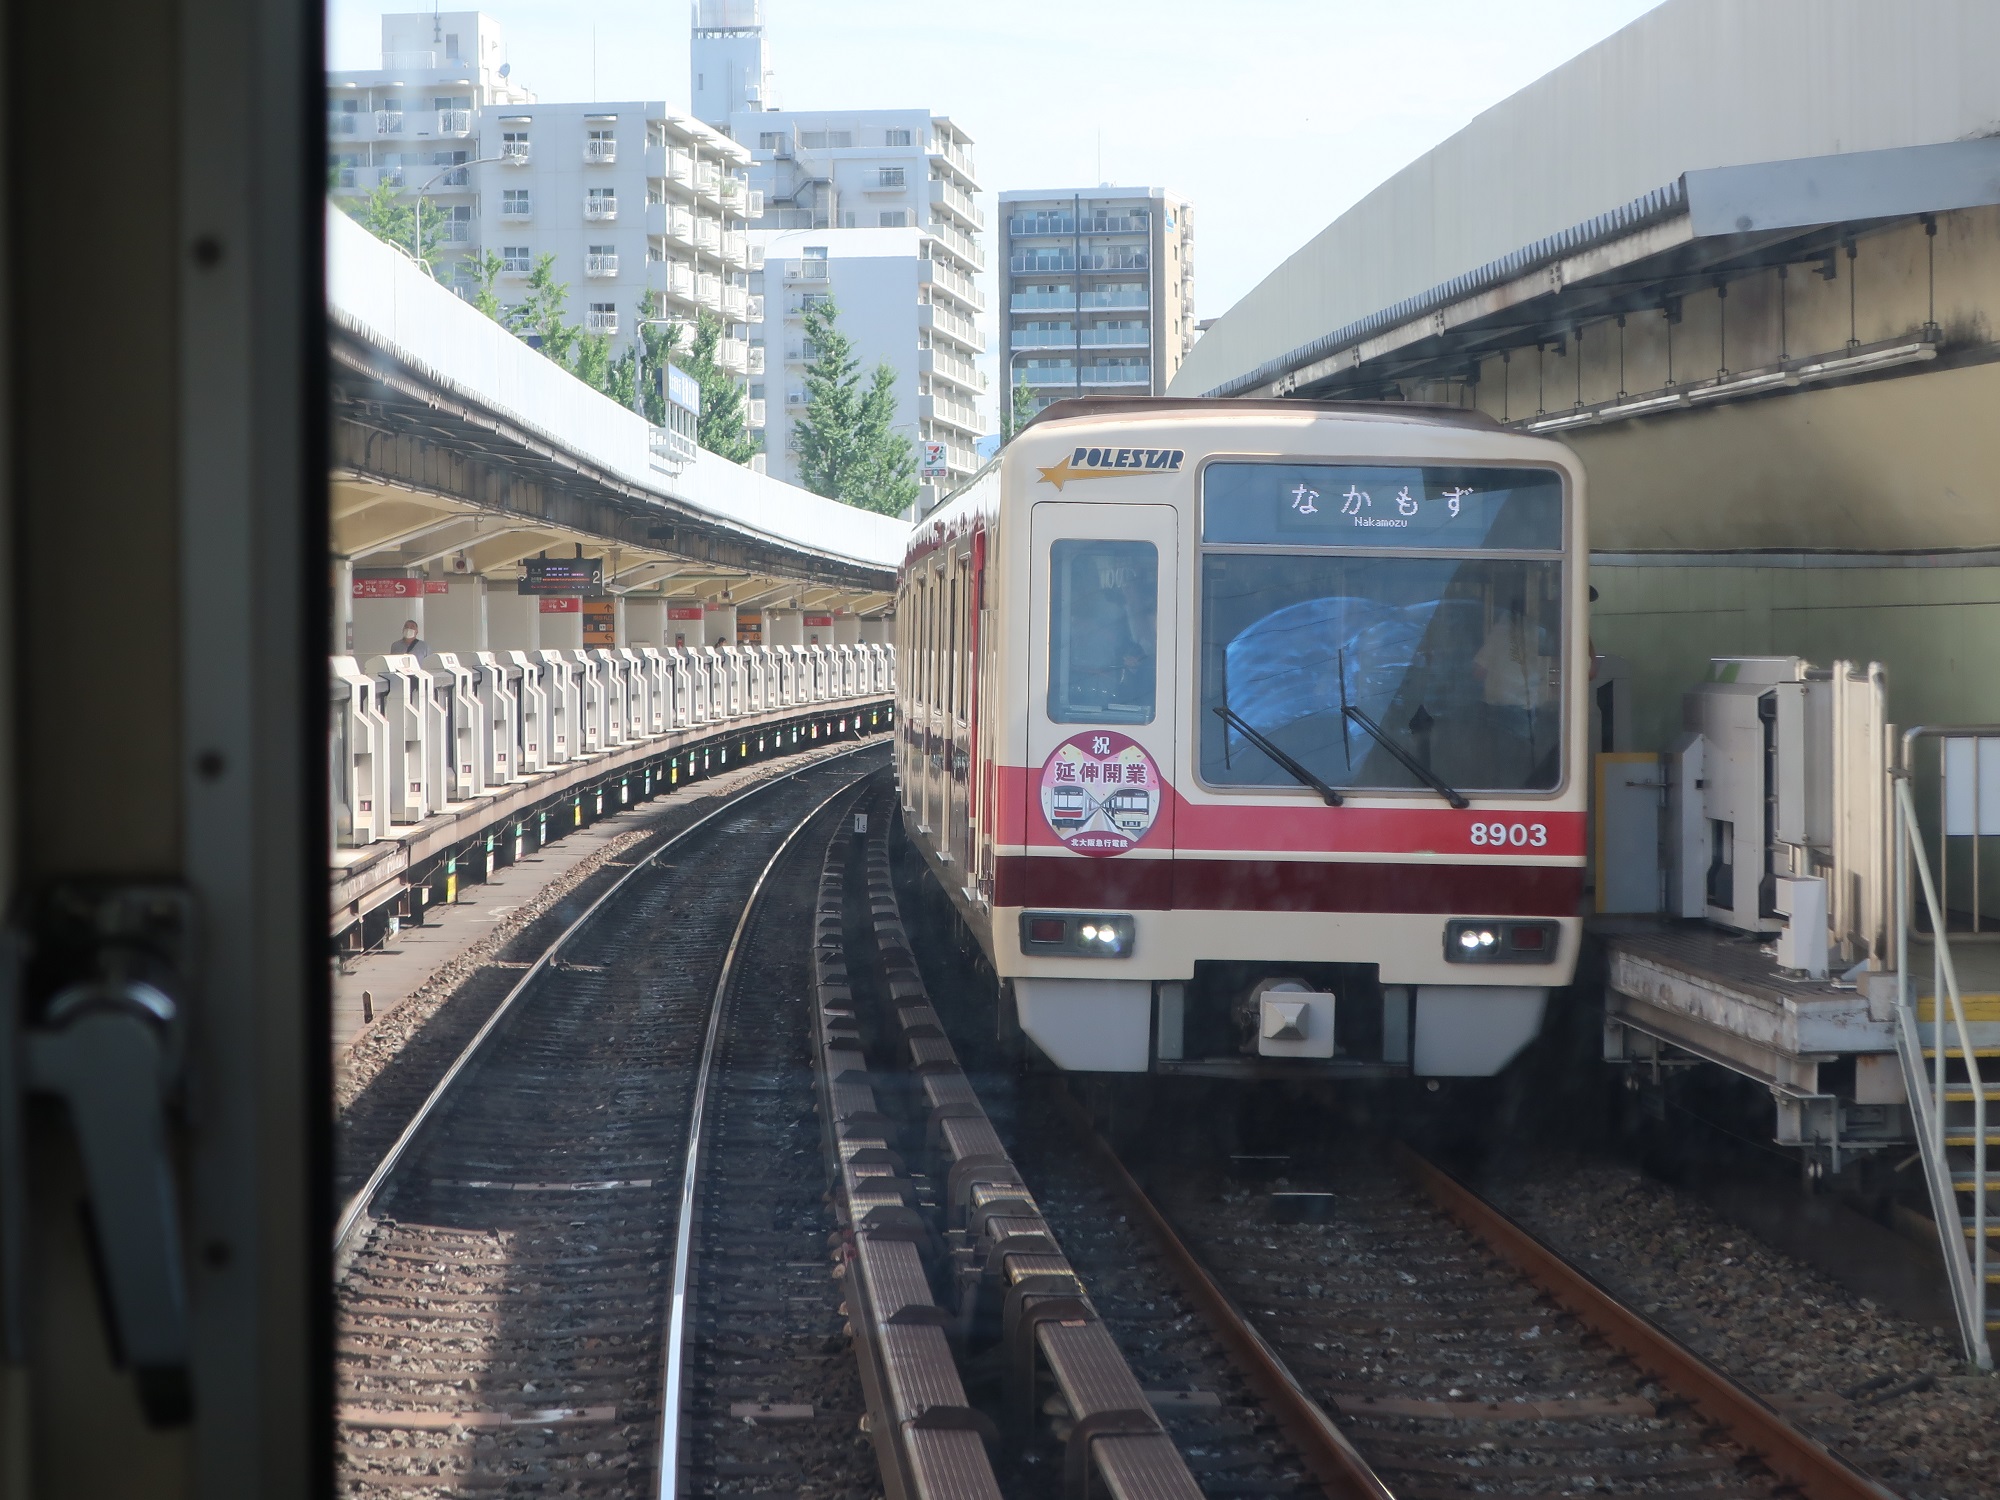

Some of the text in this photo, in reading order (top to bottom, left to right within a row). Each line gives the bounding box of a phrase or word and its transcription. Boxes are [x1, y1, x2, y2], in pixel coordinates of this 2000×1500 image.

[1071, 447, 1184, 469] POLESTAR
[1291, 483, 1475, 518] なかもず
[1354, 516, 1408, 528] Nakamozu
[592, 570, 601, 584] 2
[1091, 735, 1111, 755] 祝
[1055, 761, 1147, 785] 延伸開業
[1070, 838, 1129, 848] 北大阪急行電鉄
[1470, 822, 1548, 847] 8903
